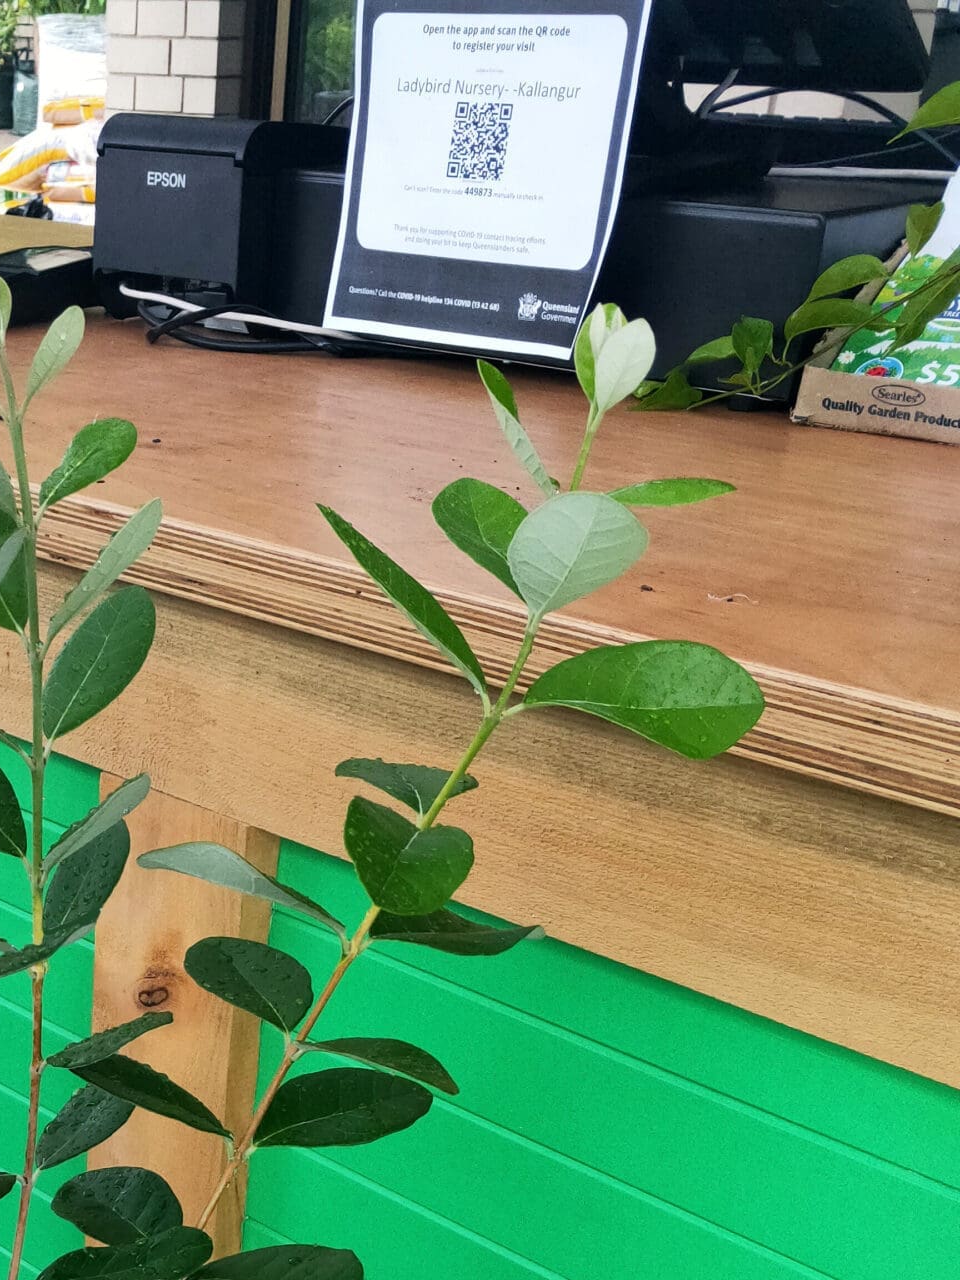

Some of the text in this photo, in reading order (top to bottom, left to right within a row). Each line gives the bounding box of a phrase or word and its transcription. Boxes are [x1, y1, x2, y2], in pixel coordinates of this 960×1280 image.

[423, 24, 444, 36] Open
[446, 25, 461, 34] the
[463, 27, 479, 36] app
[480, 25, 495, 35] and
[519, 26, 533, 35] the
[535, 26, 547, 37] QR
[550, 27, 570, 36] code
[453, 41, 535, 53] to register your visit
[397, 77, 451, 96] Ladybird
[147, 171, 186, 188] EPSON
[464, 187, 493, 197] 449873
[394, 223, 409, 233] Thank
[428, 228, 456, 238] supporting
[483, 232, 504, 241] contact
[505, 234, 525, 244] tracing
[472, 242, 515, 253] Queenslanders
[348, 285, 378, 296] Questions?
[397, 291, 420, 301] COVID-19
[878, 388, 916, 403] Searles
[822, 397, 865, 415] Quality
[867, 404, 911, 421] Garden
